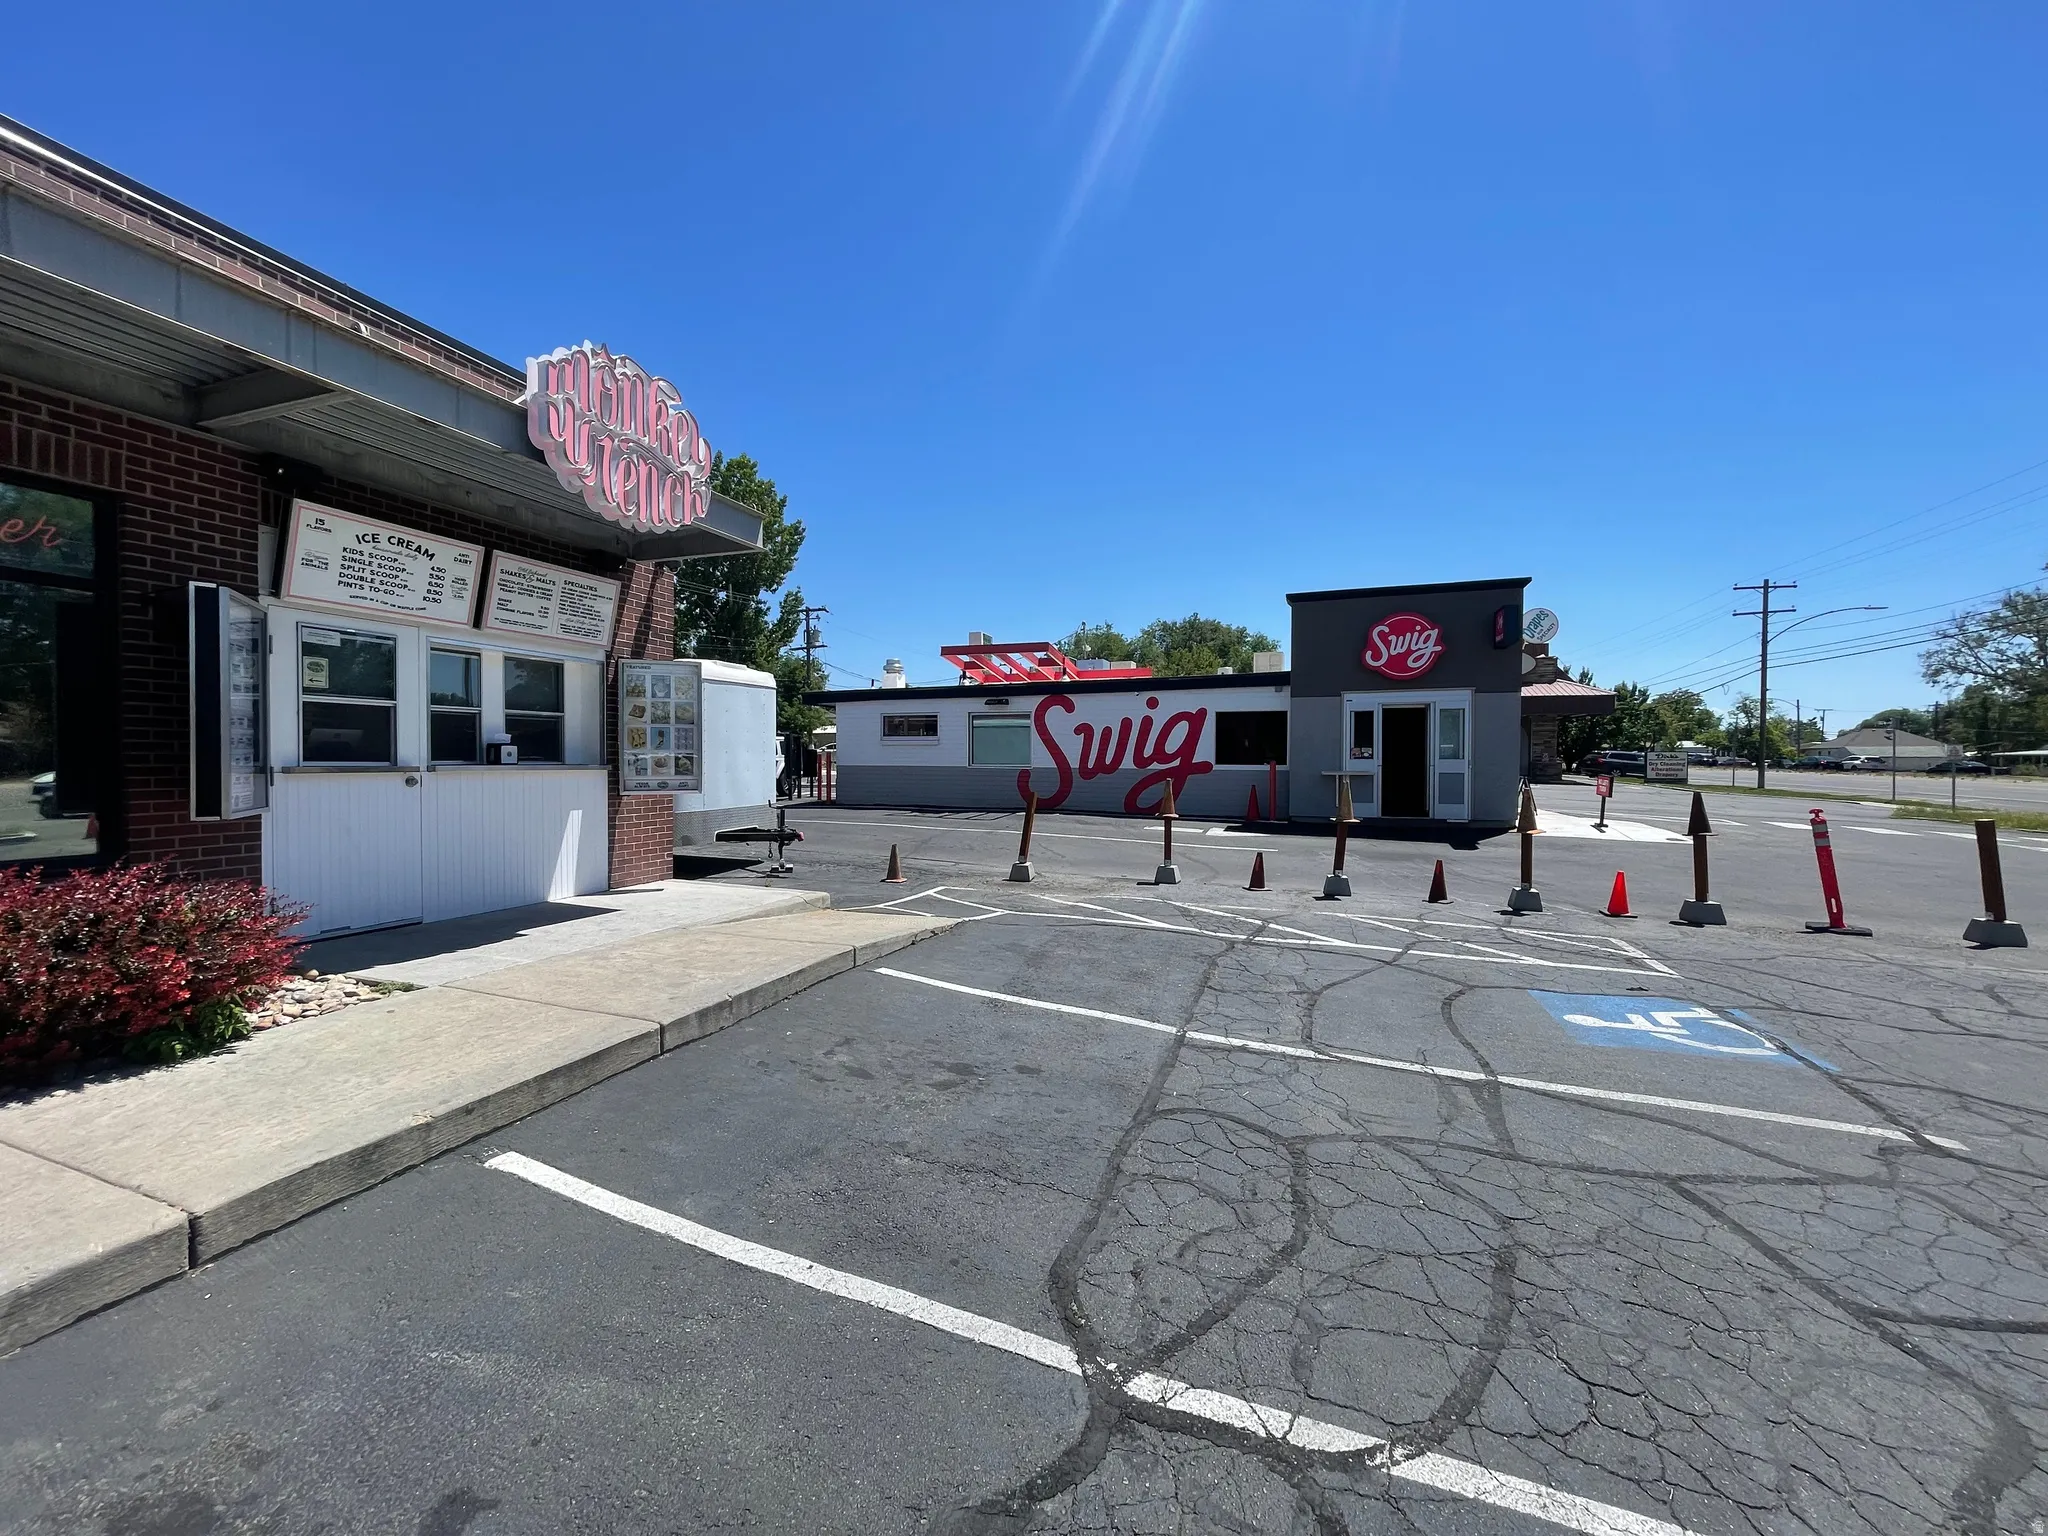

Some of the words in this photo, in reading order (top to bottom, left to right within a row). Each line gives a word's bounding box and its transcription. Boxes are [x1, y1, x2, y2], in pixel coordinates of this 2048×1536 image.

[306, 524, 332, 533] FLAVORS
[355, 533, 381, 544] ICE
[387, 536, 435, 561] CREAM
[340, 564, 366, 573] SPLIT
[341, 555, 374, 567] SINGLE
[429, 573, 445, 581] 5.50
[342, 547, 364, 556] KIDS
[430, 566, 446, 574] 4.50
[454, 557, 472, 565] DAIRY
[339, 572, 376, 584] DOUBLE
[500, 569, 526, 579] SHAKES
[526, 575, 535, 583] &
[536, 577, 556, 586] MALTS
[564, 580, 598, 592] SPECIALTIES
[338, 580, 364, 590] PINTS
[423, 596, 442, 604] 10.50
[1523, 610, 1549, 638] Drapes
[1537, 622, 1556, 641] SPECIALTY
[1365, 625, 1442, 668] Swig
[1017, 694, 1214, 814] Swig
